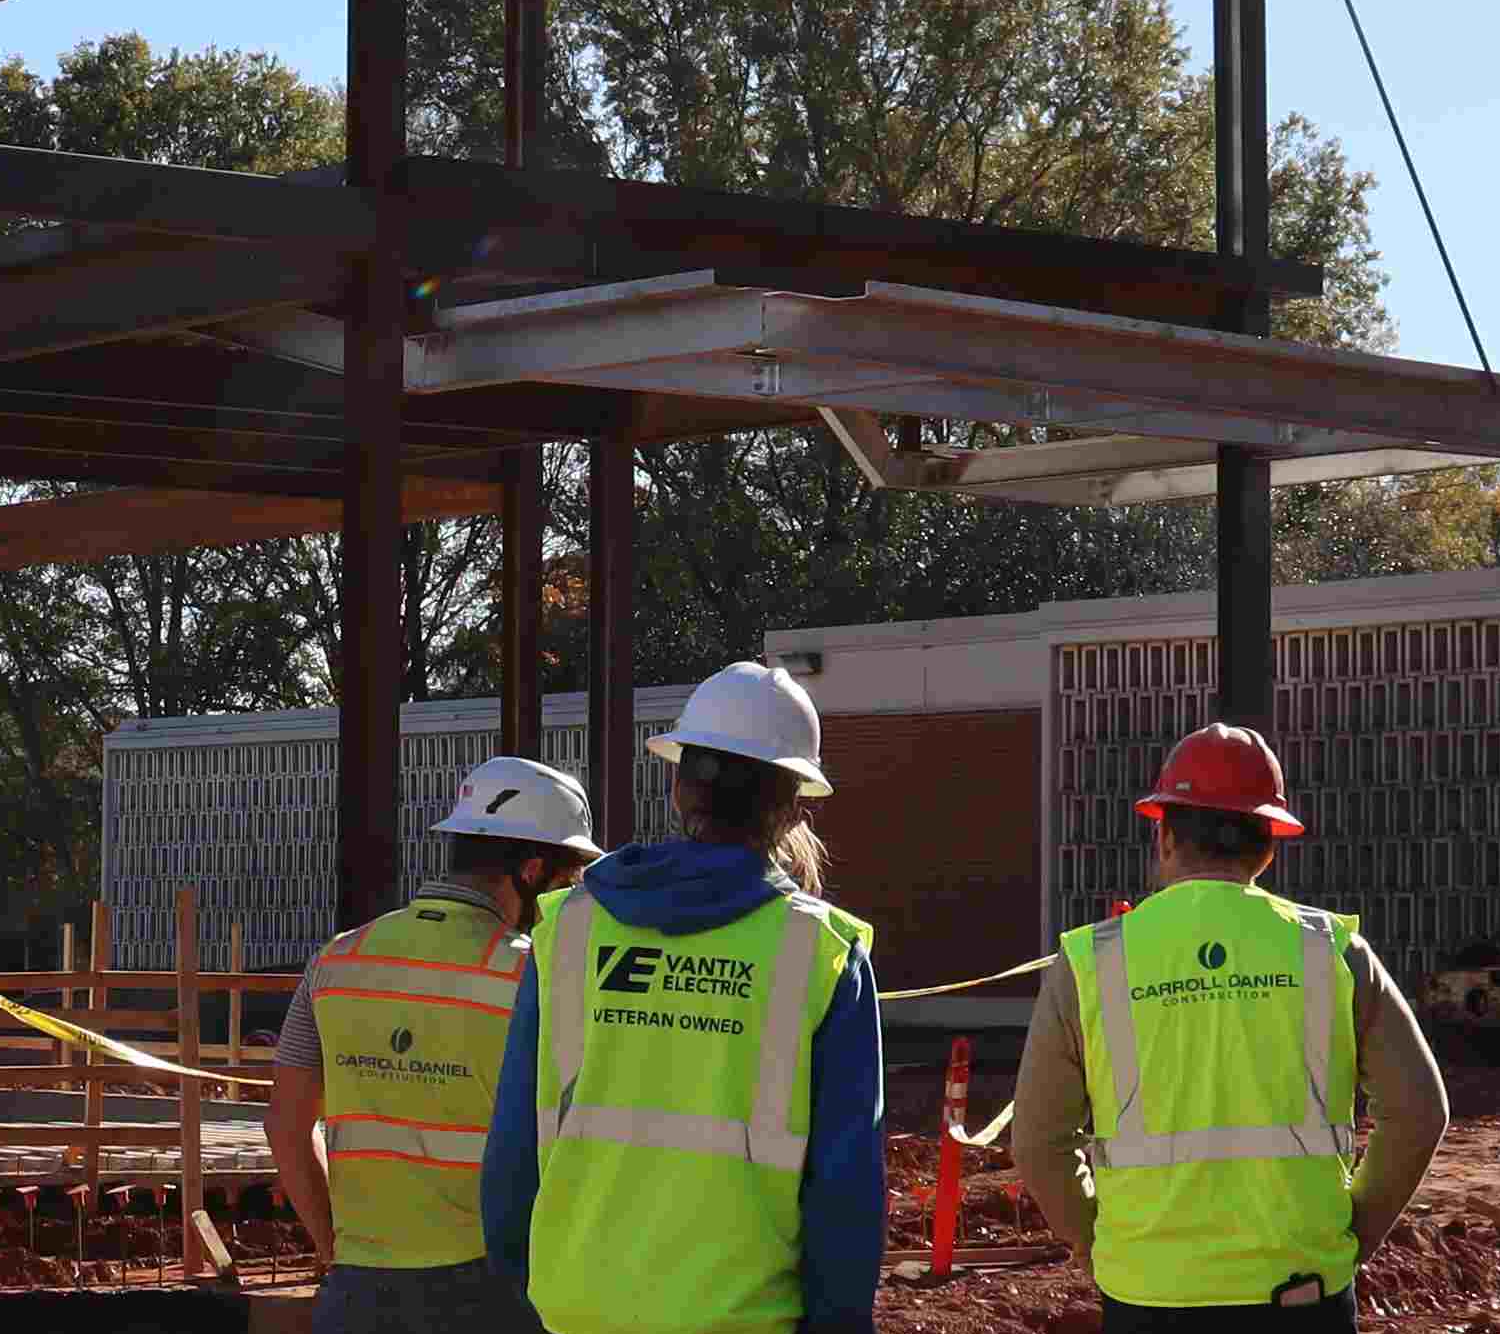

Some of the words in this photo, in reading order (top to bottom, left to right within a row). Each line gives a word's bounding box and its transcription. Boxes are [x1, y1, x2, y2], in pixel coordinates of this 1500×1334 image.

[665, 954, 755, 981] VANTIX
[662, 974, 752, 999] ELECTRIC
[1130, 975, 1223, 1001] CARROLL
[1227, 972, 1300, 989] DANIEL
[593, 1008, 675, 1028] VETERAN
[679, 1014, 744, 1035] OWNED
[409, 1060, 473, 1077] DANIEL
